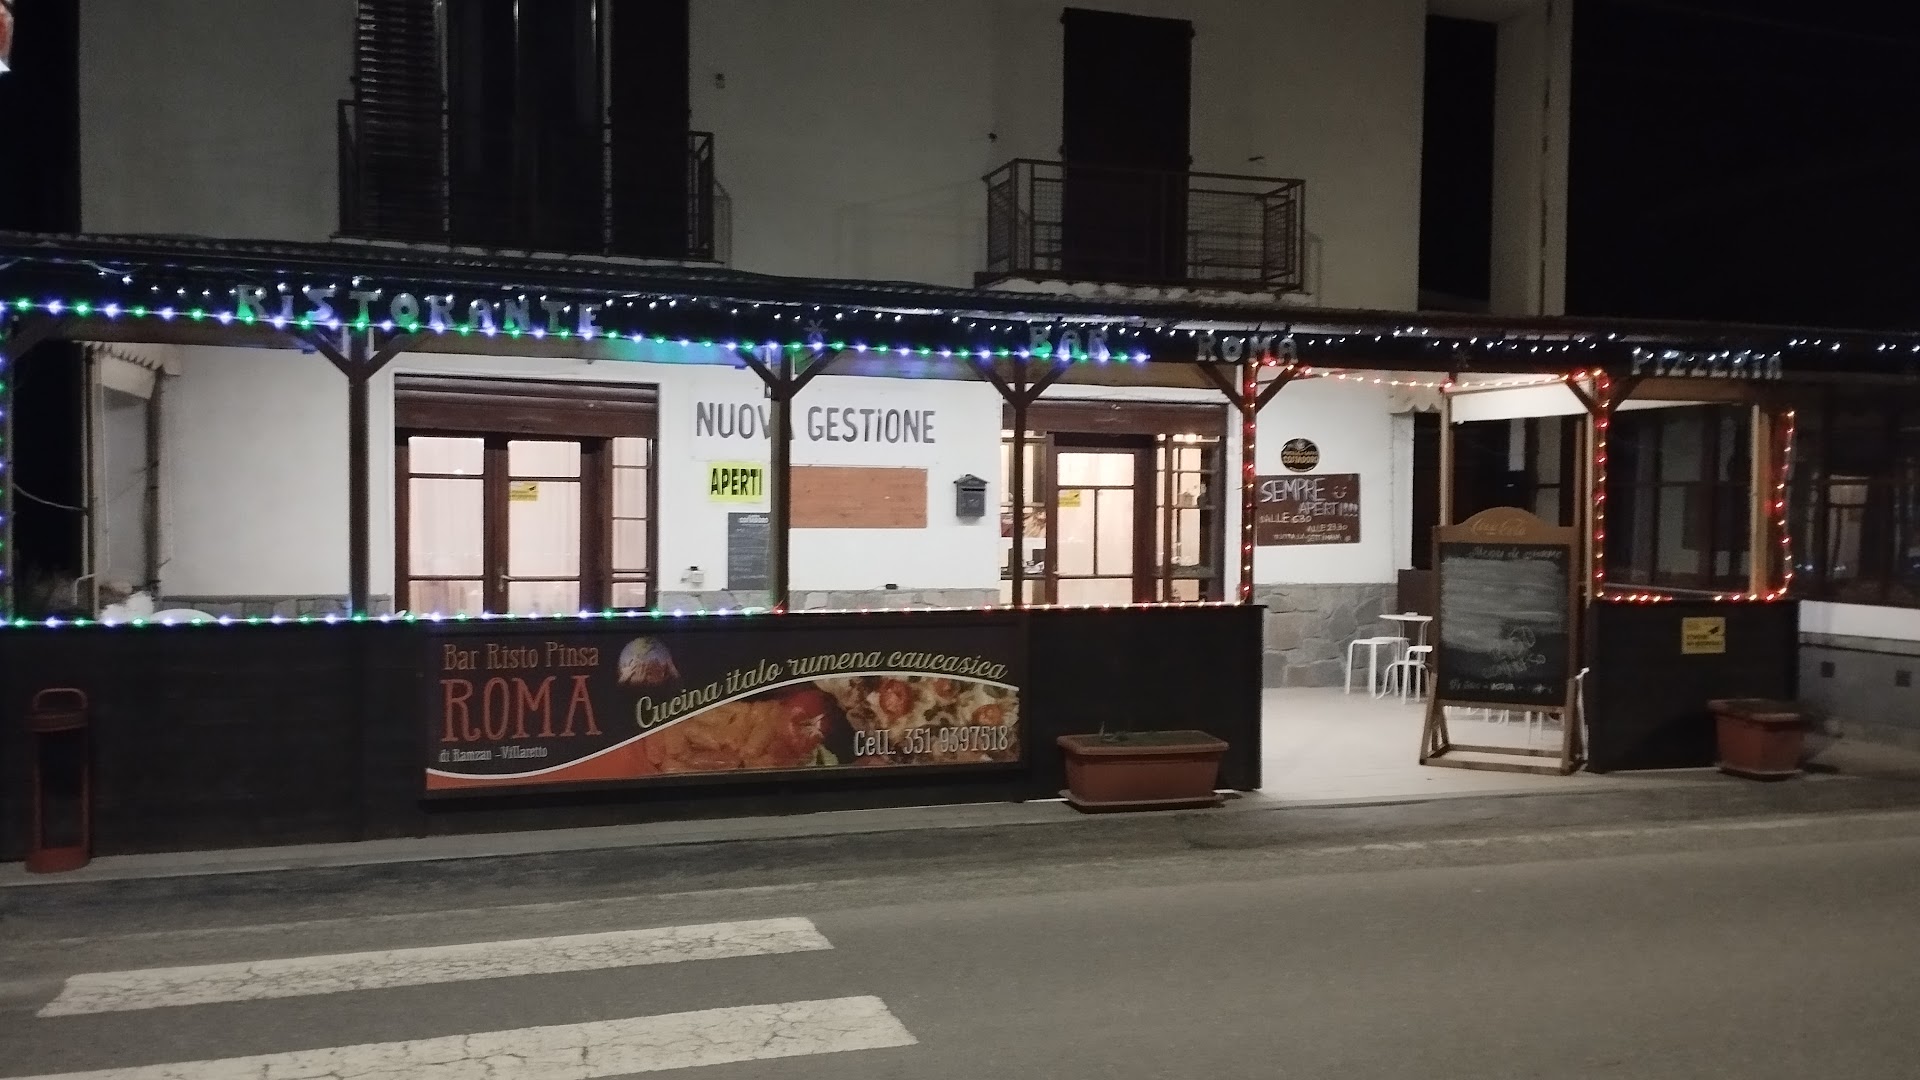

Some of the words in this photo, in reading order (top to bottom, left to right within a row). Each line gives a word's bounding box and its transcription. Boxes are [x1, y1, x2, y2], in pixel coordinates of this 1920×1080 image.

[1029, 325, 1110, 360] BAR
[1196, 334, 1298, 363] ROMA
[710, 468, 763, 496] APERTI
[1260, 478, 1326, 503] SEMPRE
[443, 643, 478, 671] Bar
[486, 643, 539, 670] Risto
[545, 641, 600, 668] Pinsa
[636, 682, 724, 729] Cucina
[726, 659, 784, 695] italo
[786, 650, 886, 676] rumena
[886, 650, 1009, 680] caucasica
[439, 675, 603, 742] ROMA
[903, 727, 933, 754] 351
[940, 725, 1009, 751] 9397518
[439, 749, 450, 762] di
